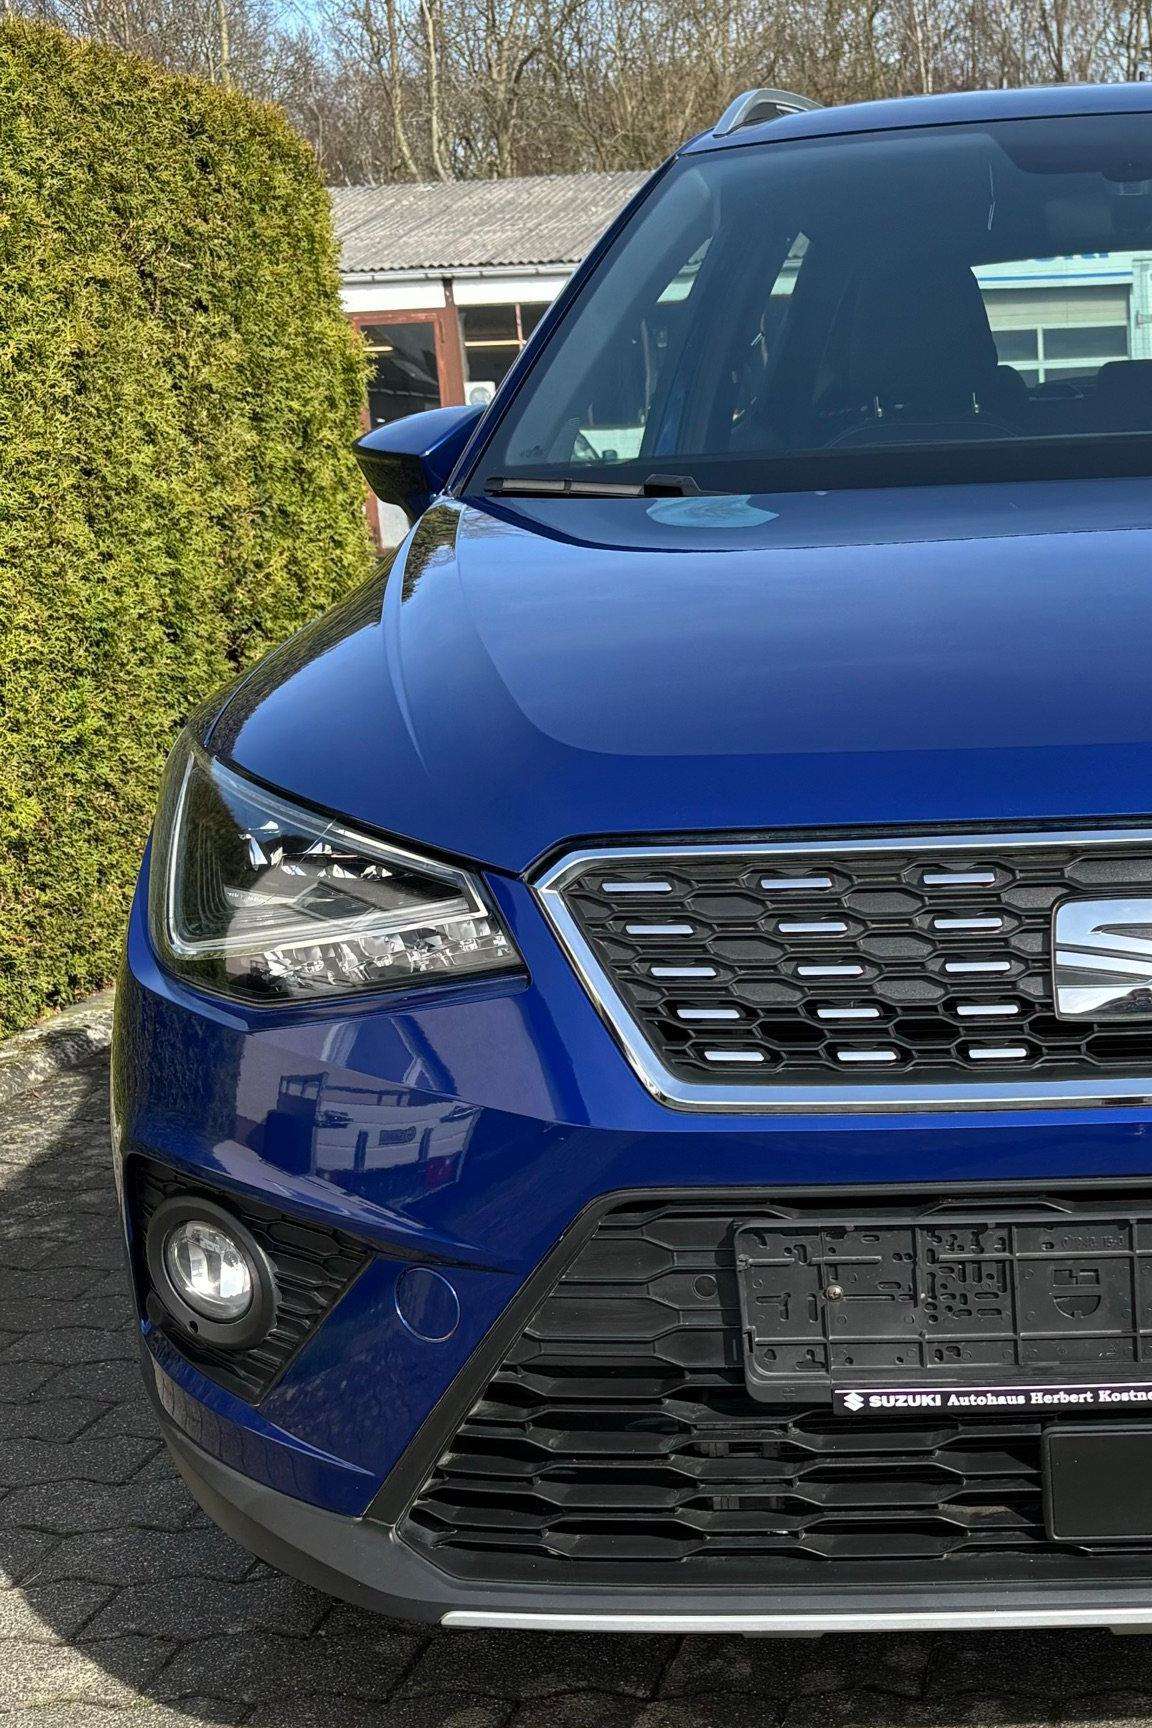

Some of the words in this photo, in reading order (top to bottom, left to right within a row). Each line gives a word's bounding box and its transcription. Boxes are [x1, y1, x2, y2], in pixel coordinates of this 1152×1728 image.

[869, 1394, 942, 1407] SUZUKI
[947, 1393, 1026, 1406] Autohaus
[1030, 1391, 1094, 1405] Herbert
